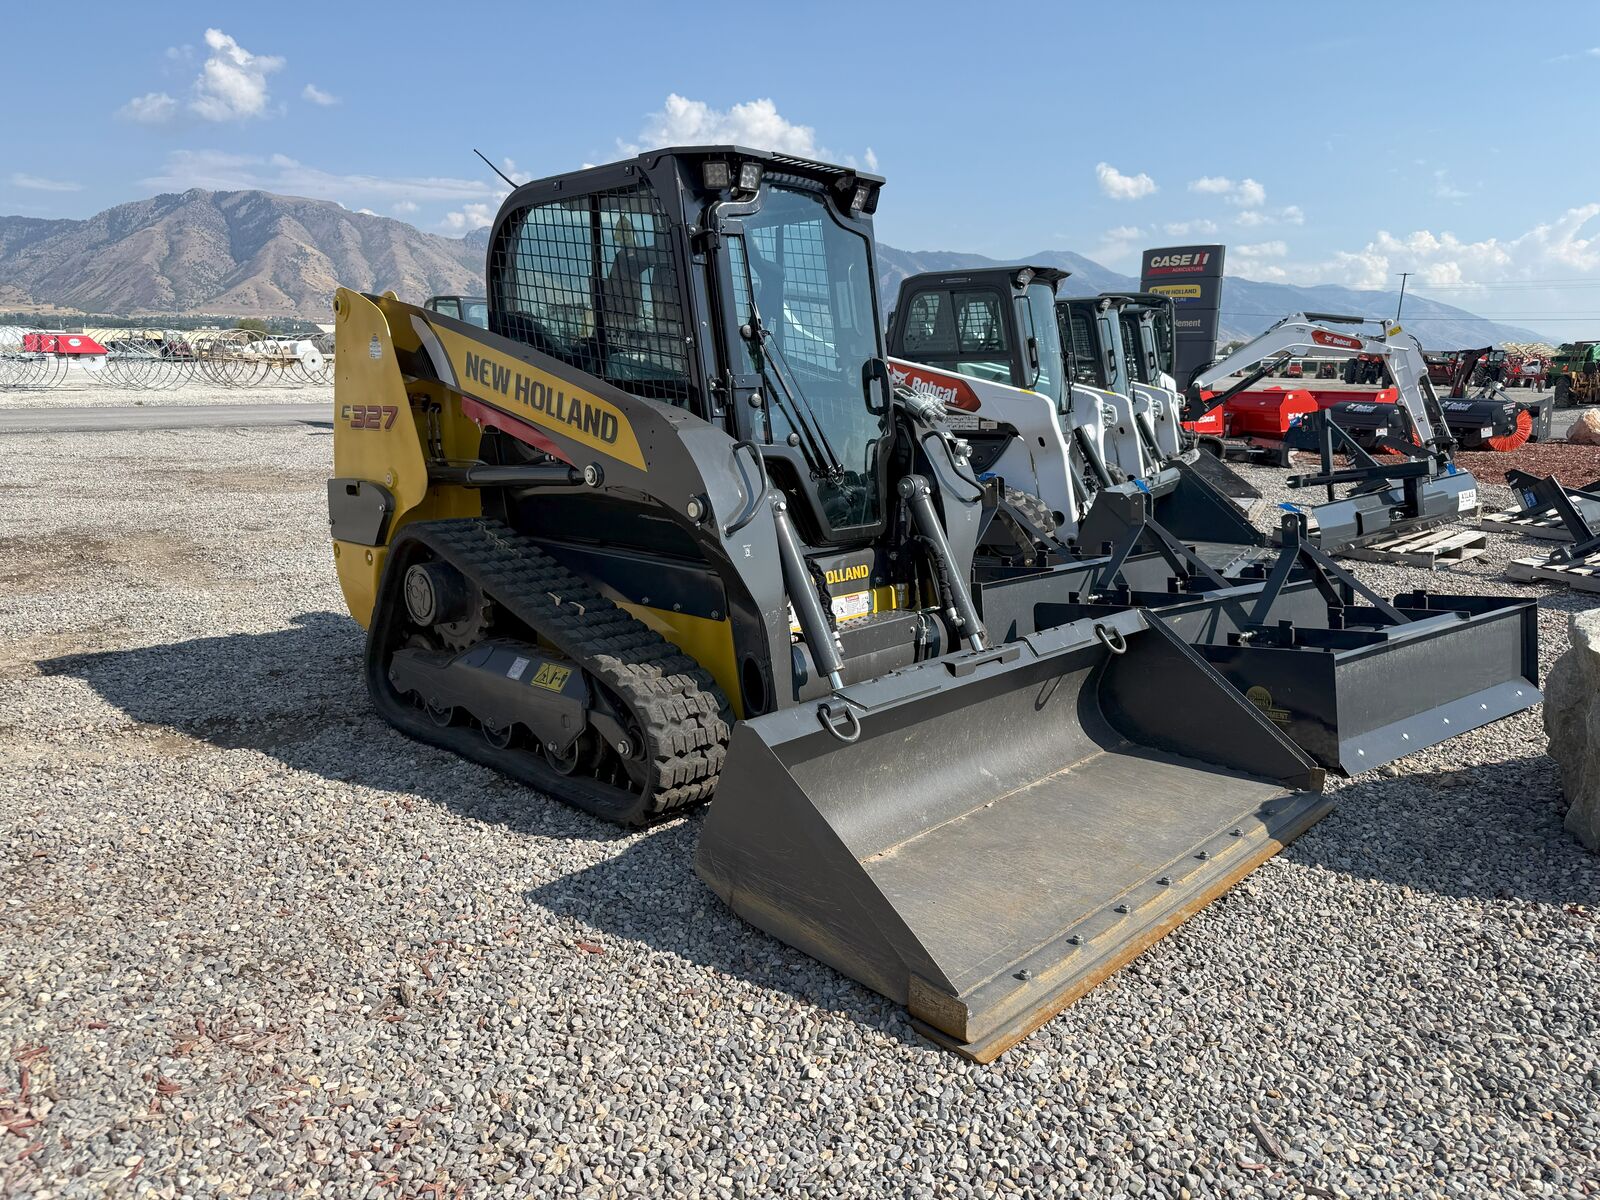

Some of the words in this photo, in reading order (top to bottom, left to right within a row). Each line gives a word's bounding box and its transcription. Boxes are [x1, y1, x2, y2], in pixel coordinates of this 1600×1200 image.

[1151, 254, 1192, 268] CASE
[1175, 319, 1201, 328] lement
[1333, 337, 1352, 347] Bobcat
[465, 351, 511, 395] NEW
[515, 373, 619, 444] HOLLAND
[912, 377, 958, 402] Bobcat
[341, 405, 399, 430] C327
[825, 564, 869, 585] OLLAND
[1265, 711, 1289, 720] PMENT
